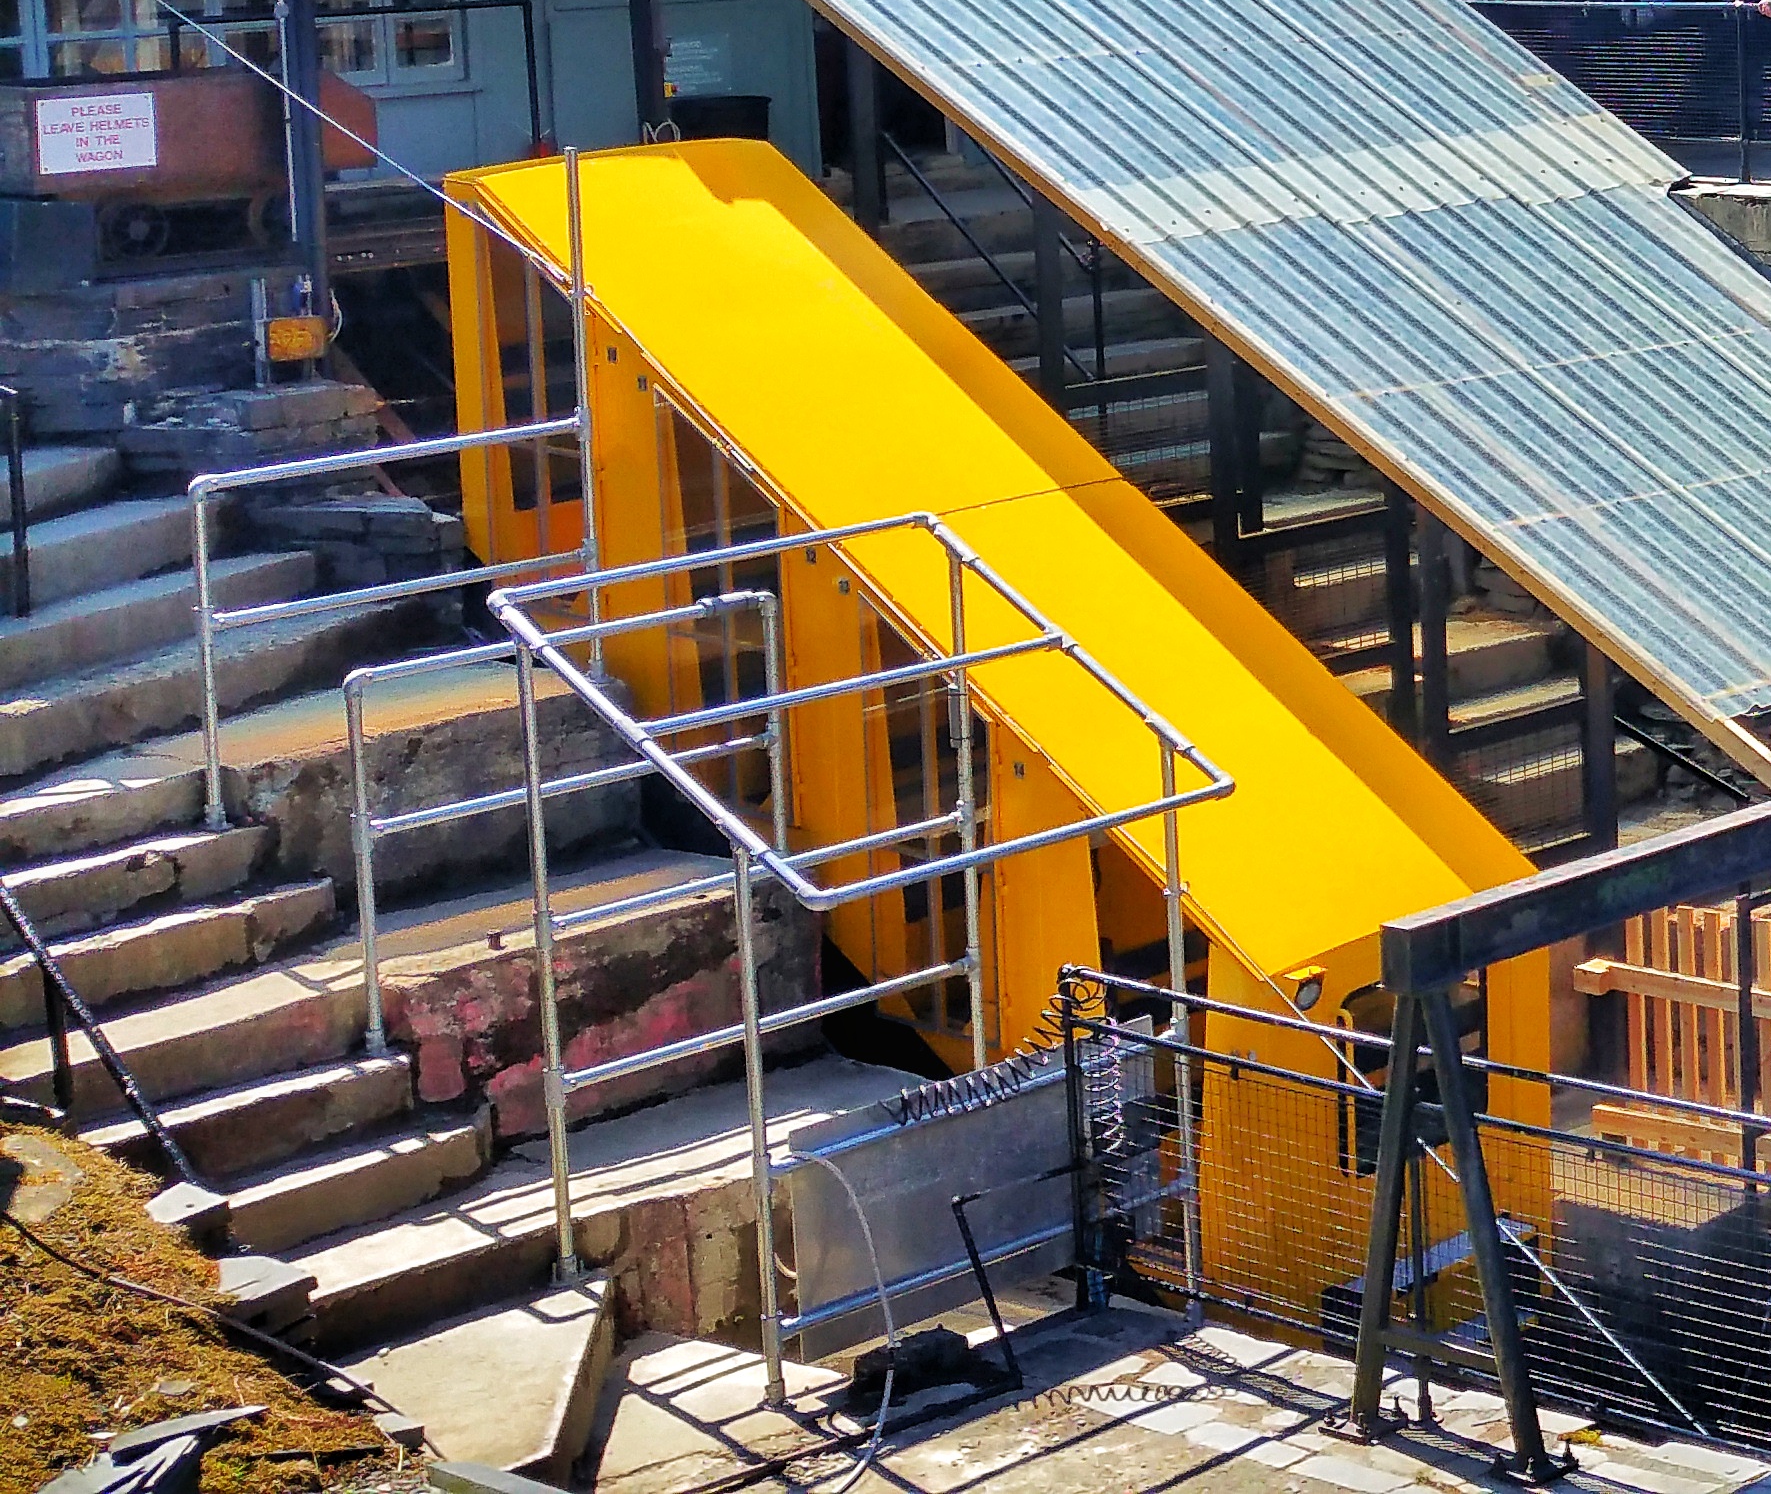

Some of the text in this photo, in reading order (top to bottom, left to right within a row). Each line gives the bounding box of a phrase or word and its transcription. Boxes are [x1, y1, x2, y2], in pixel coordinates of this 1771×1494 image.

[71, 103, 122, 117] PLEASE
[43, 117, 150, 135] LEAVE HELMETS
[75, 134, 121, 148] IN THE
[75, 149, 123, 163] WAGON
